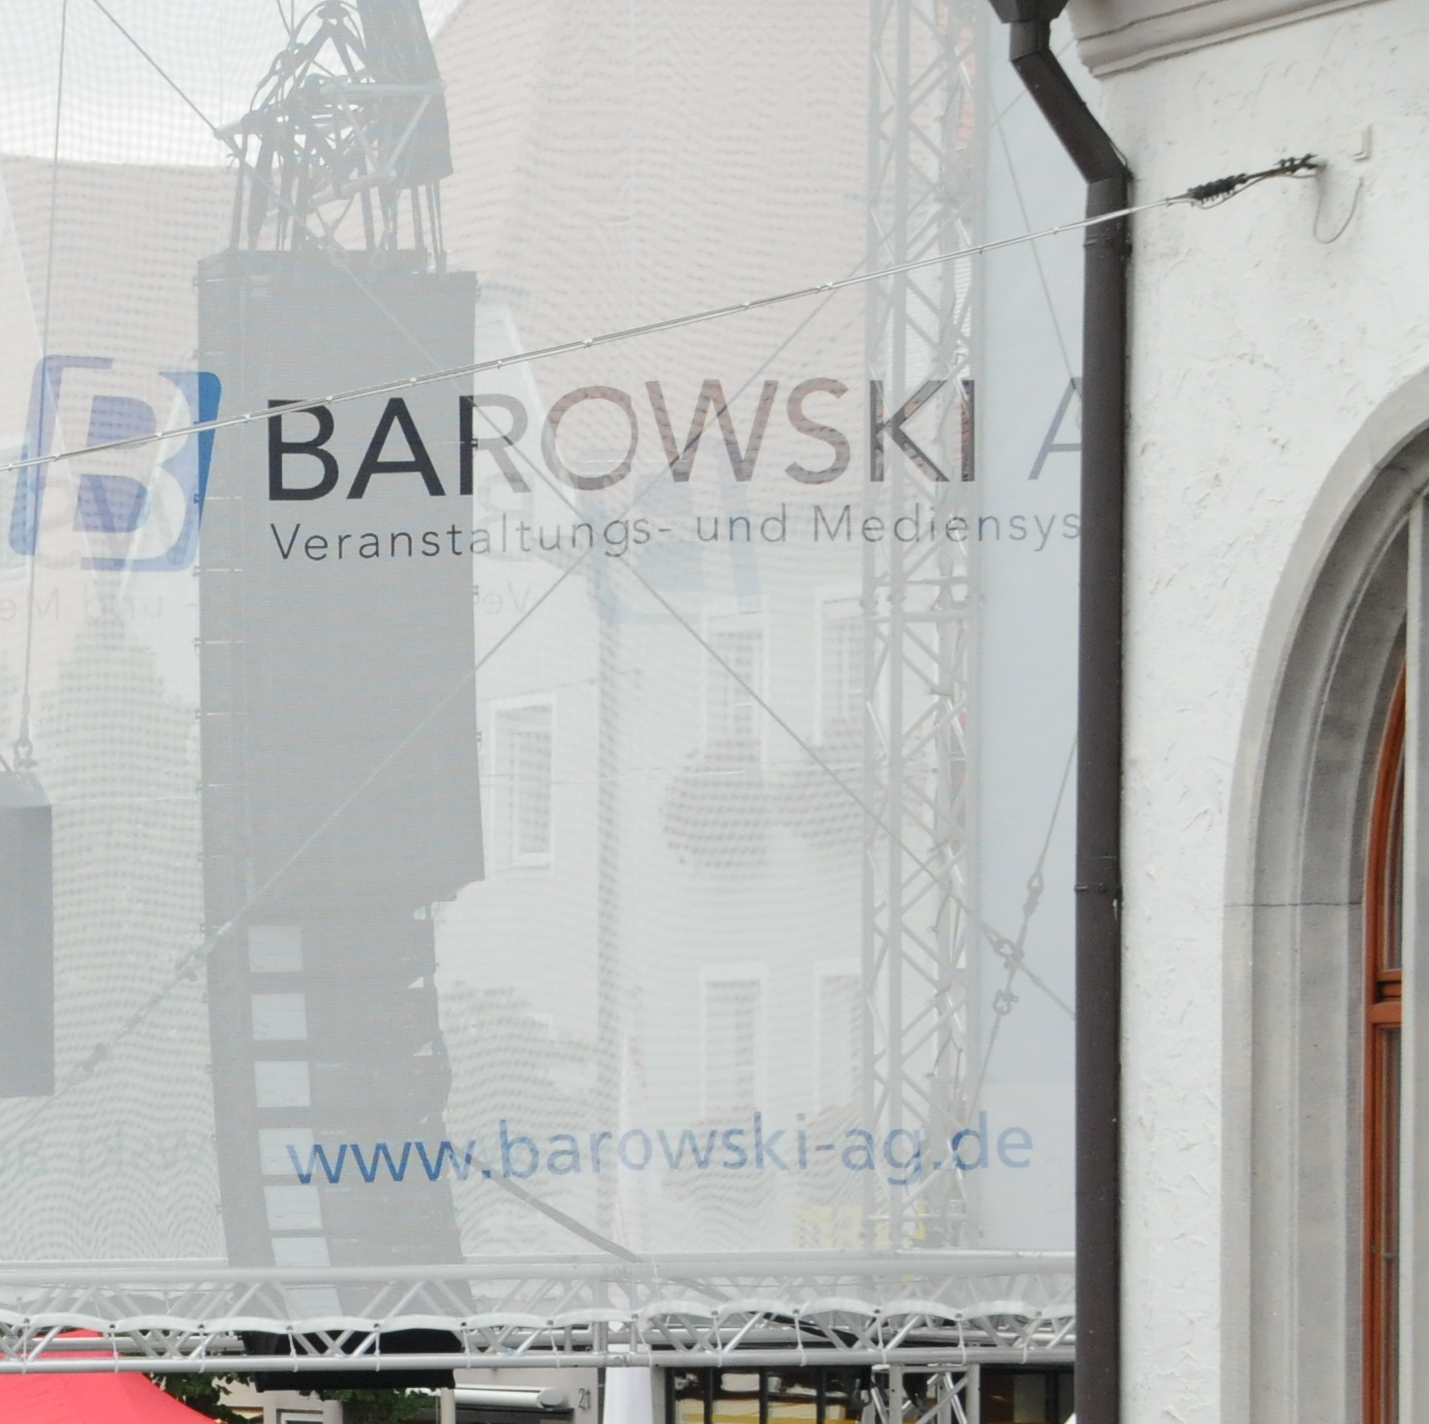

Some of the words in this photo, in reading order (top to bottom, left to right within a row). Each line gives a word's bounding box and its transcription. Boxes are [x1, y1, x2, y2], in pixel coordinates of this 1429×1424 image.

[267, 376, 976, 502] BAROWSKI
[1028, 377, 1083, 481] A
[270, 513, 672, 561] Veranstaltungs-
[696, 503, 788, 543] und
[813, 502, 1082, 552] Mediensys
[285, 1110, 1035, 1186] www.barowski-ag.de
